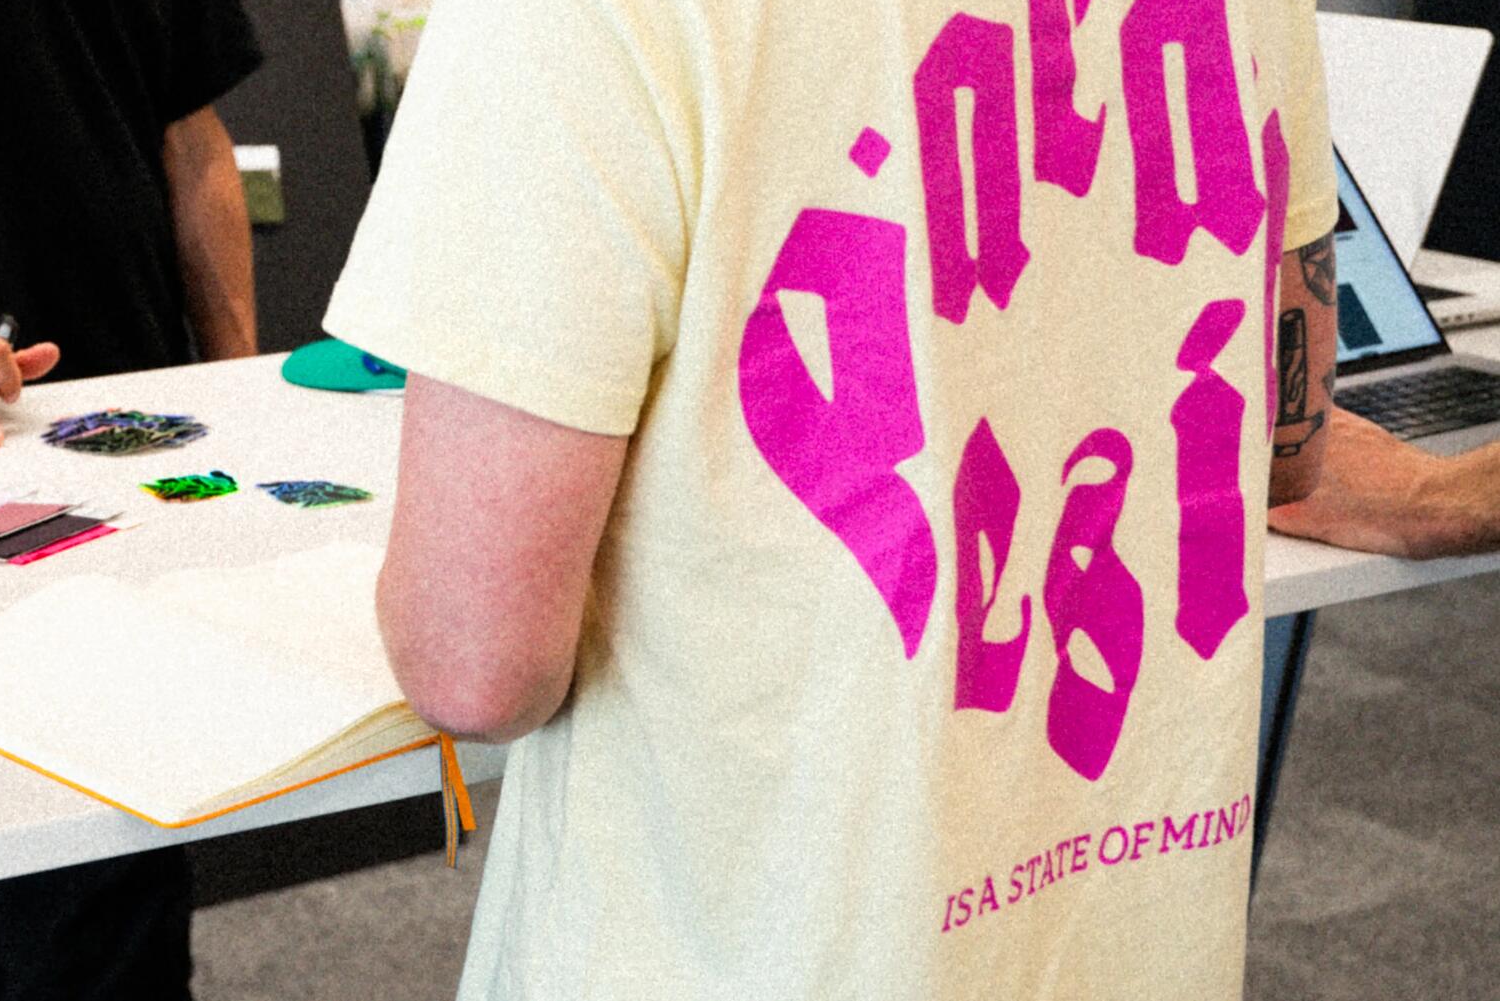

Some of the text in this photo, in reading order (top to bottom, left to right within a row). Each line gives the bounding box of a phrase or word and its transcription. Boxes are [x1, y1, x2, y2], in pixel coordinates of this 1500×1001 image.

[941, 793, 1251, 934] IS A STATE OF MIND
